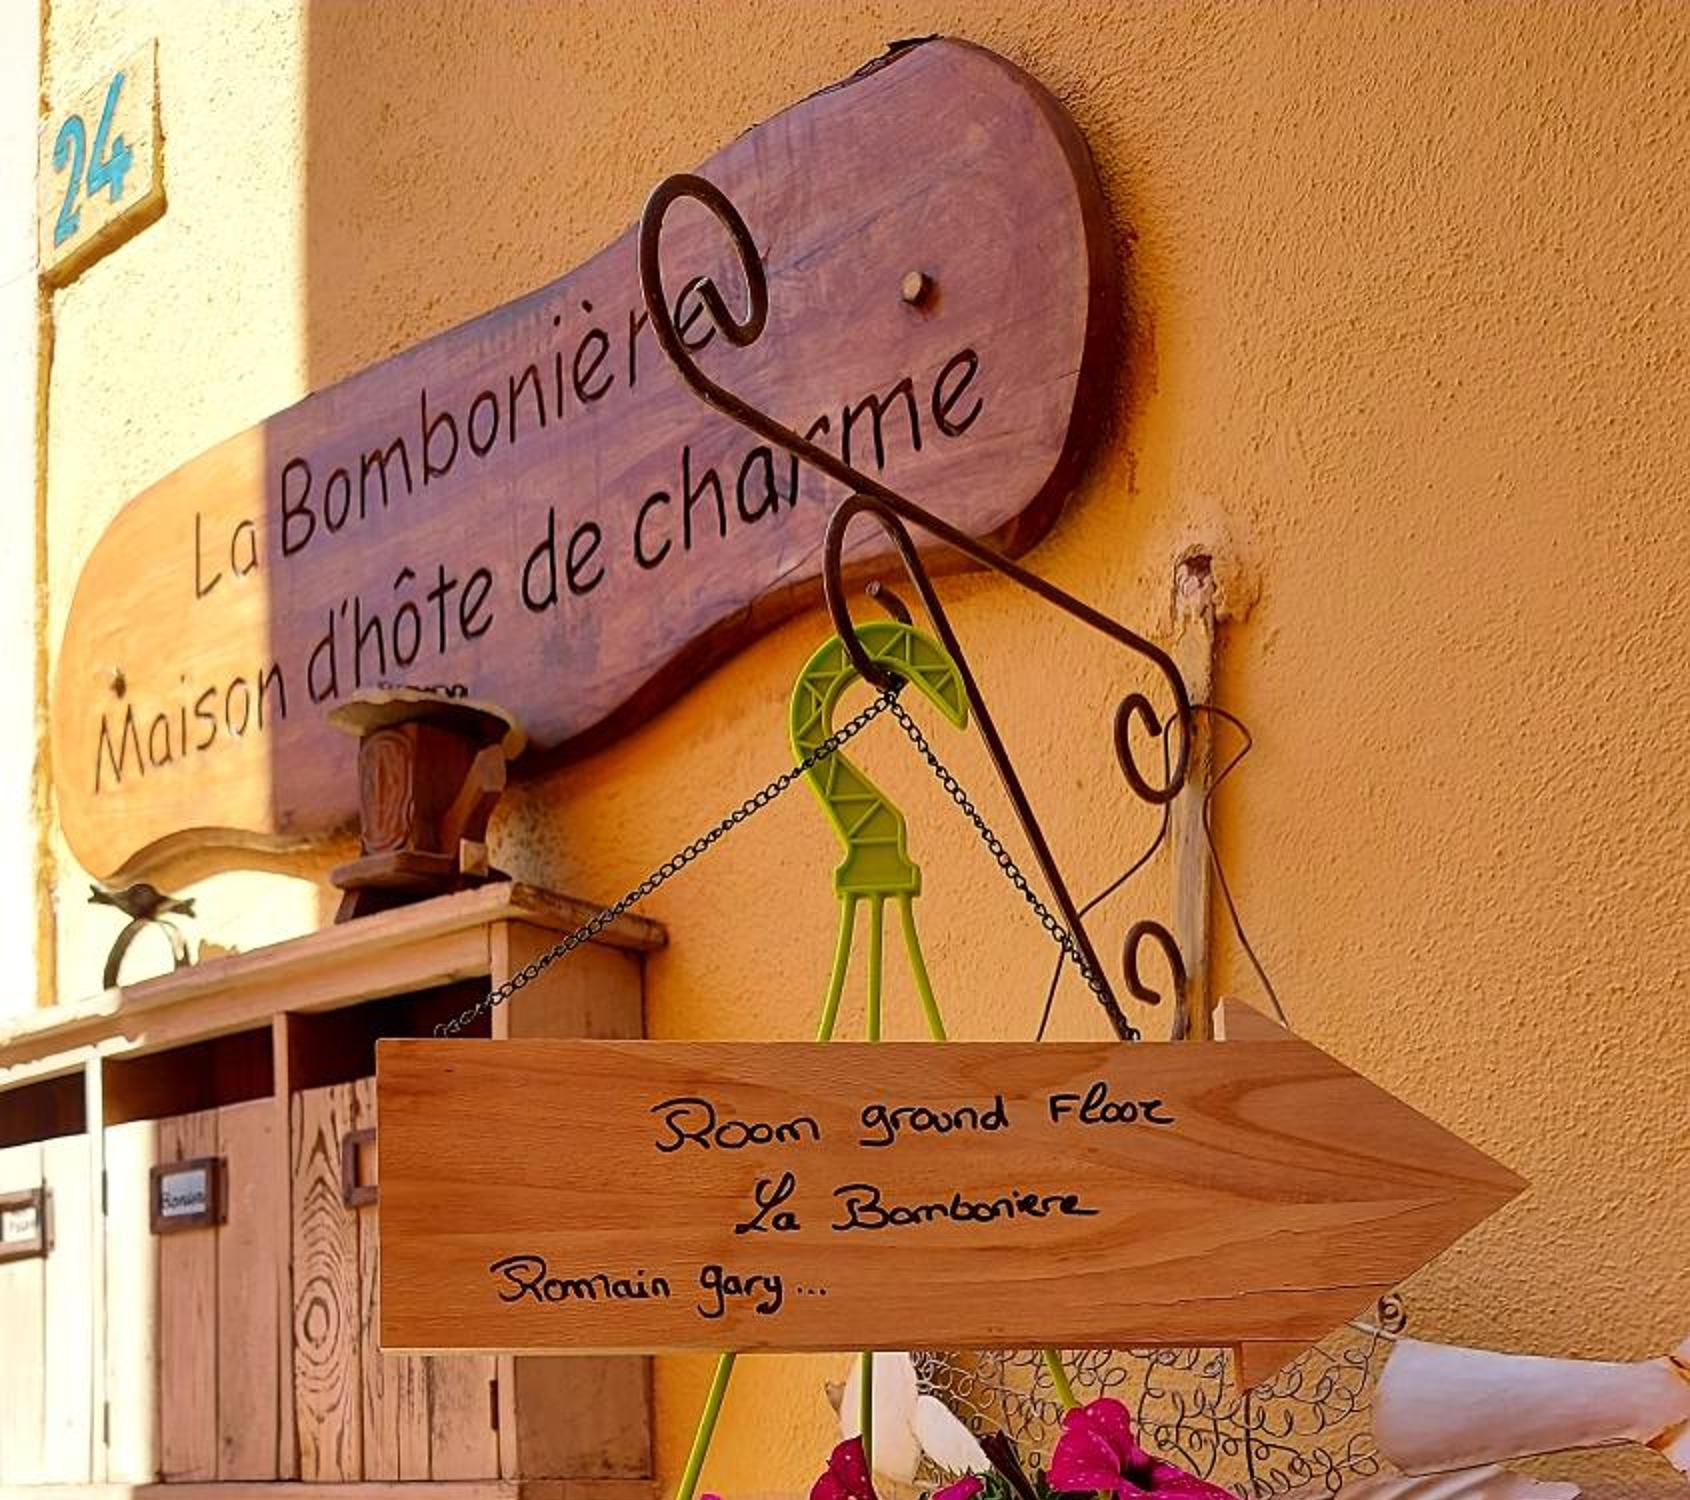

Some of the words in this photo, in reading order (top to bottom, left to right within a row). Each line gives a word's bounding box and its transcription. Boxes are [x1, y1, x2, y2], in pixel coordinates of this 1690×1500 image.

[52, 70, 133, 248] 24
[193, 512, 262, 598] La
[279, 276, 718, 557] Bombonière
[93, 665, 288, 794] Maison
[306, 566, 493, 705] d'hôte
[521, 505, 605, 613] de
[633, 347, 984, 571] charme
[650, 1097, 822, 1153] Room
[859, 1095, 1010, 1148] ground
[734, 1171, 800, 1235] La
[831, 1183, 1101, 1231] Bomboniere
[490, 1255, 671, 1303] Romain
